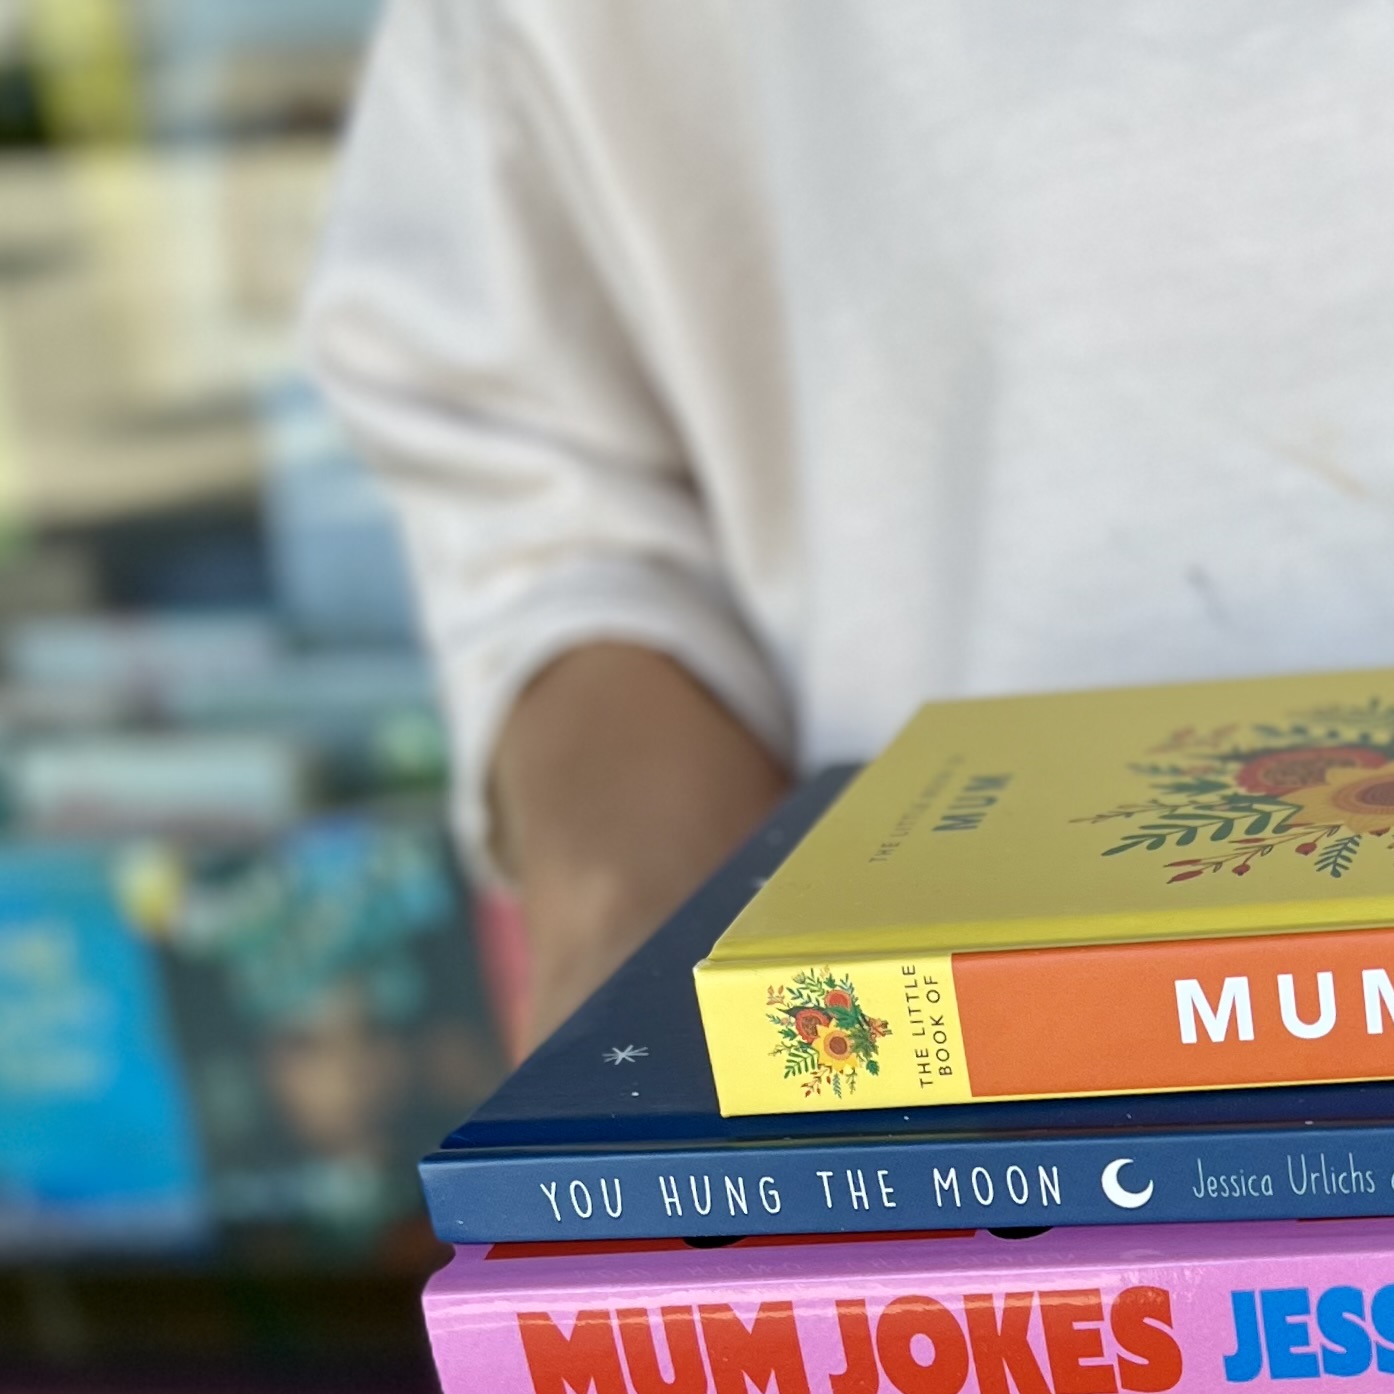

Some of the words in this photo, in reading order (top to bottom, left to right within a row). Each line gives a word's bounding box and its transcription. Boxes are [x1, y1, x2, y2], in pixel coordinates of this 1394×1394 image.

[931, 773, 1013, 832] MUM
[902, 965, 925, 1036] LITTLE
[923, 975, 940, 1003] OF
[915, 1048, 933, 1089] THE
[930, 1015, 953, 1076] BOOK
[540, 1177, 624, 1222] YOU
[659, 1174, 782, 1217] HUNG
[816, 1169, 897, 1211] THE
[933, 1165, 1062, 1208] MOON
[1193, 1158, 1274, 1198] Jessica
[1286, 1152, 1376, 1195] Urlichs
